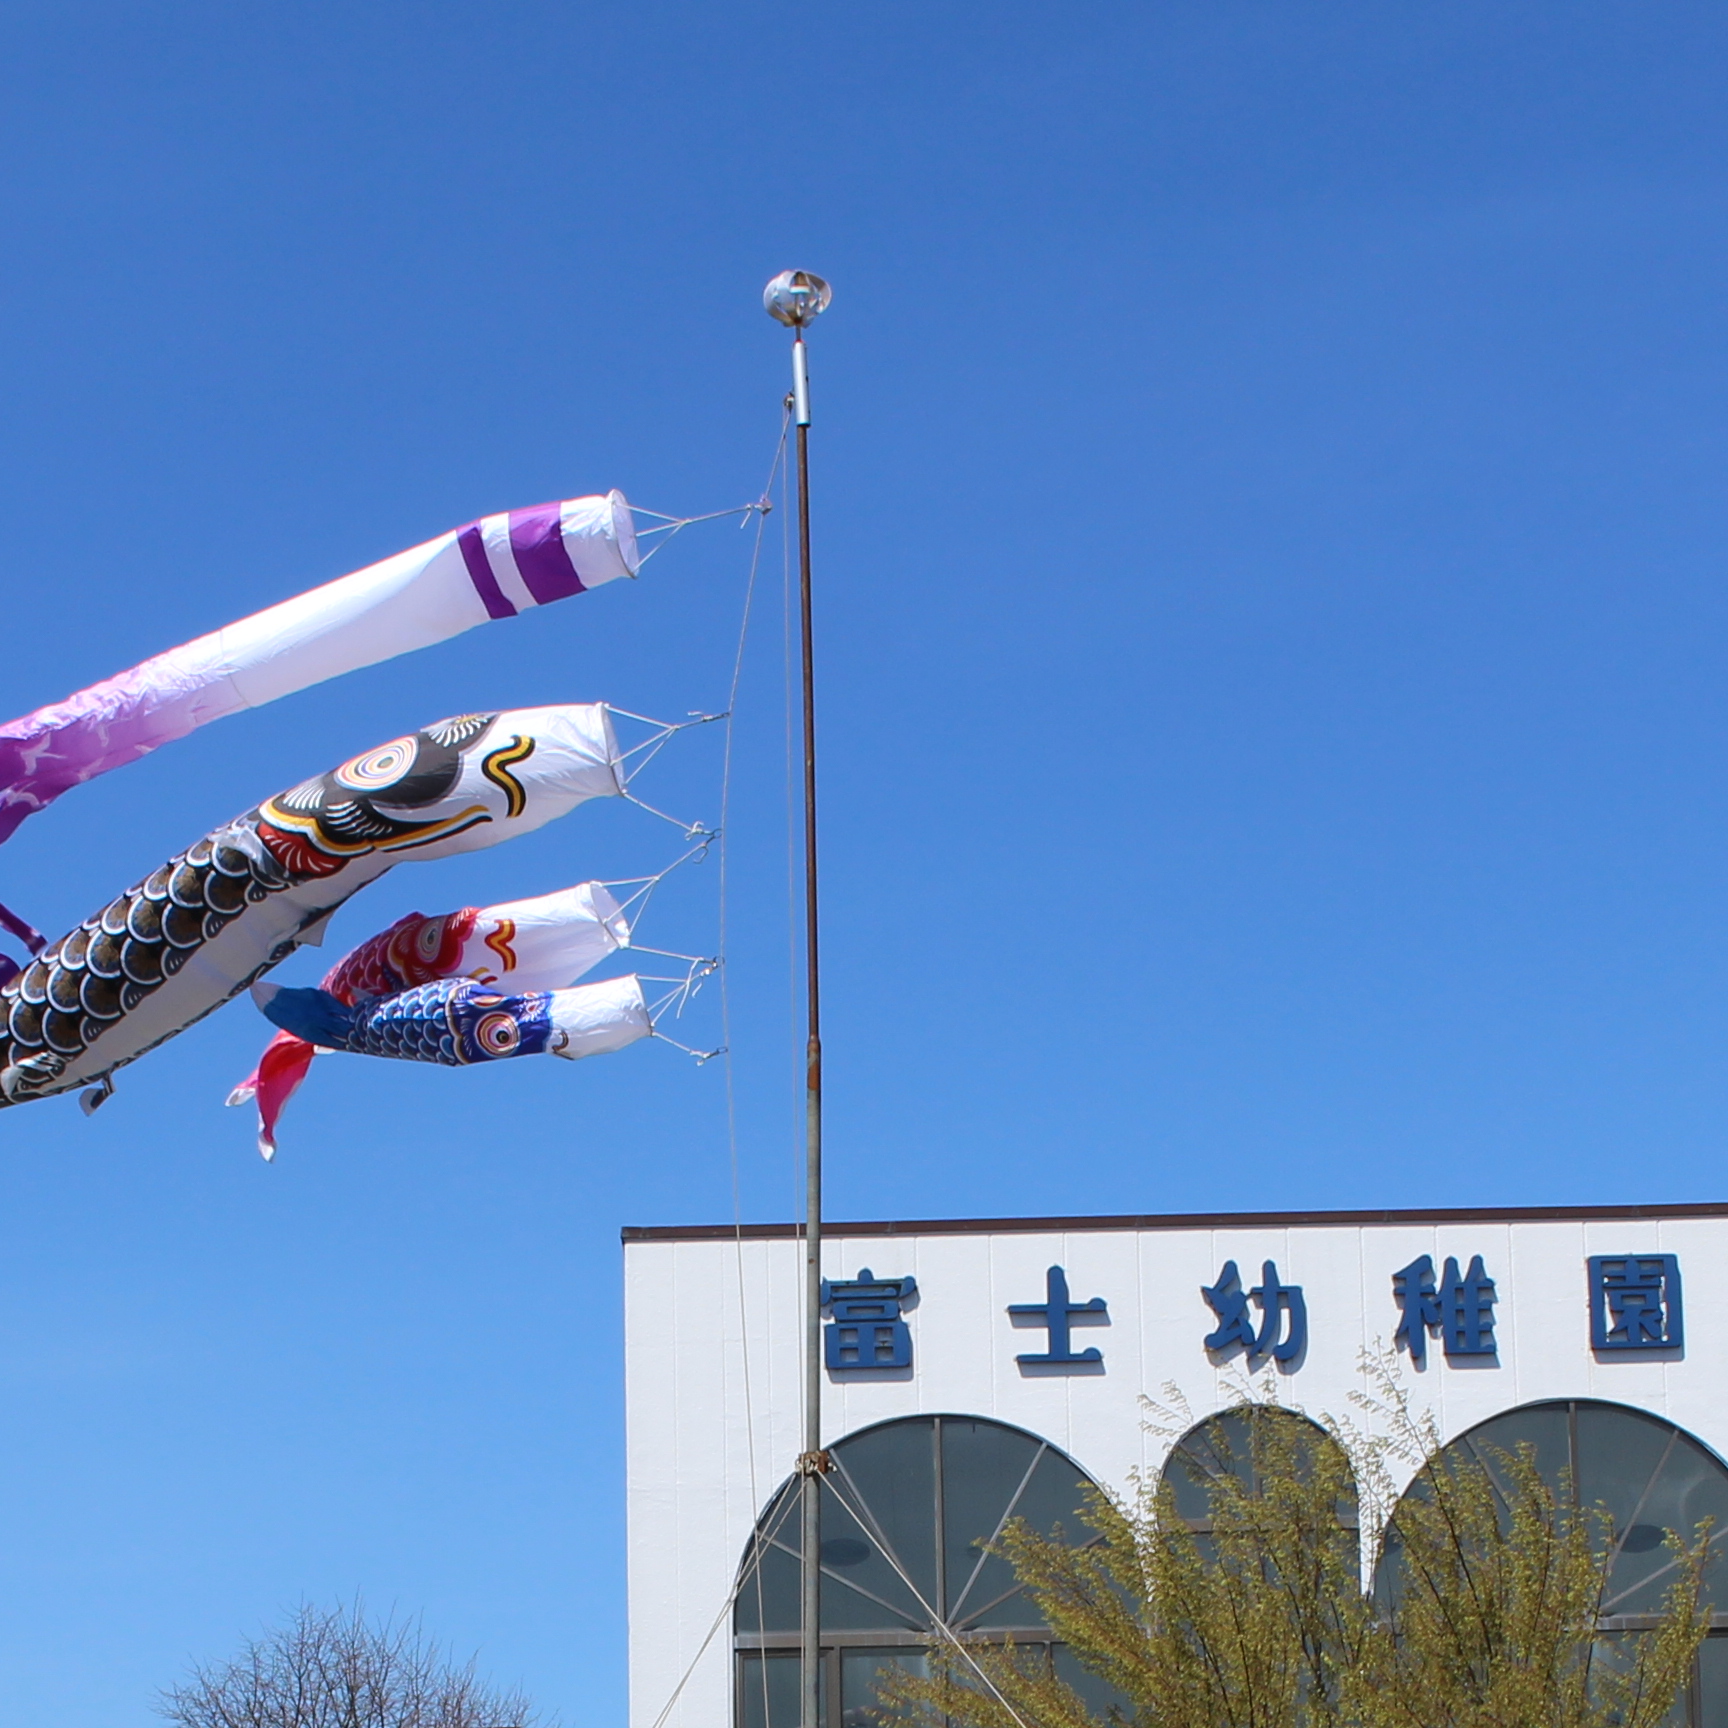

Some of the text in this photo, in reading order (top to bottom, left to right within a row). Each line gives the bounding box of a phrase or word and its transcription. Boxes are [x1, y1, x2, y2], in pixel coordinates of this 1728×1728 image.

[820, 1252, 1683, 1373] 富士幼稚園
